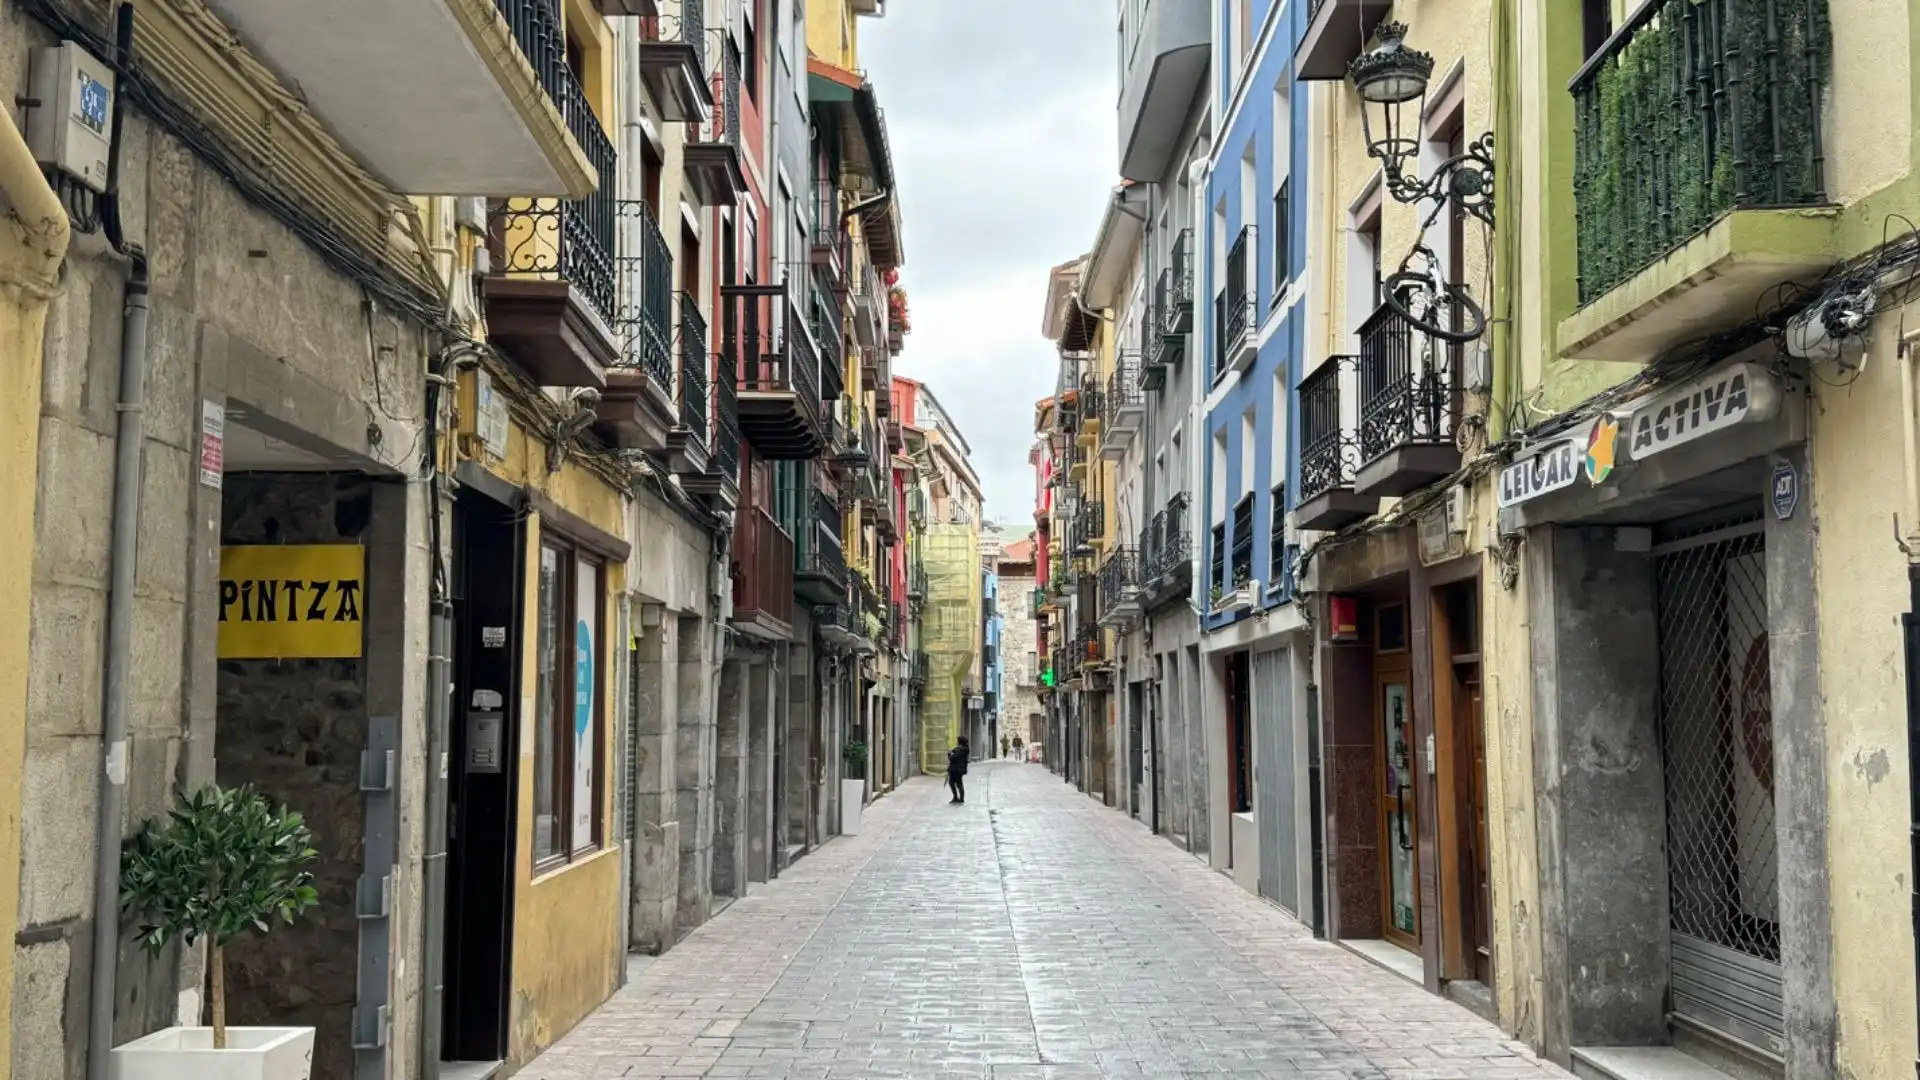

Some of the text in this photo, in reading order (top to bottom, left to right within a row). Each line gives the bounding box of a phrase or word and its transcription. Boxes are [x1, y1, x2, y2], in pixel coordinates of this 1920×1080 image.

[1503, 373, 1747, 501] LEIGAR ACTIVA
[1775, 475, 1791, 498] ADT
